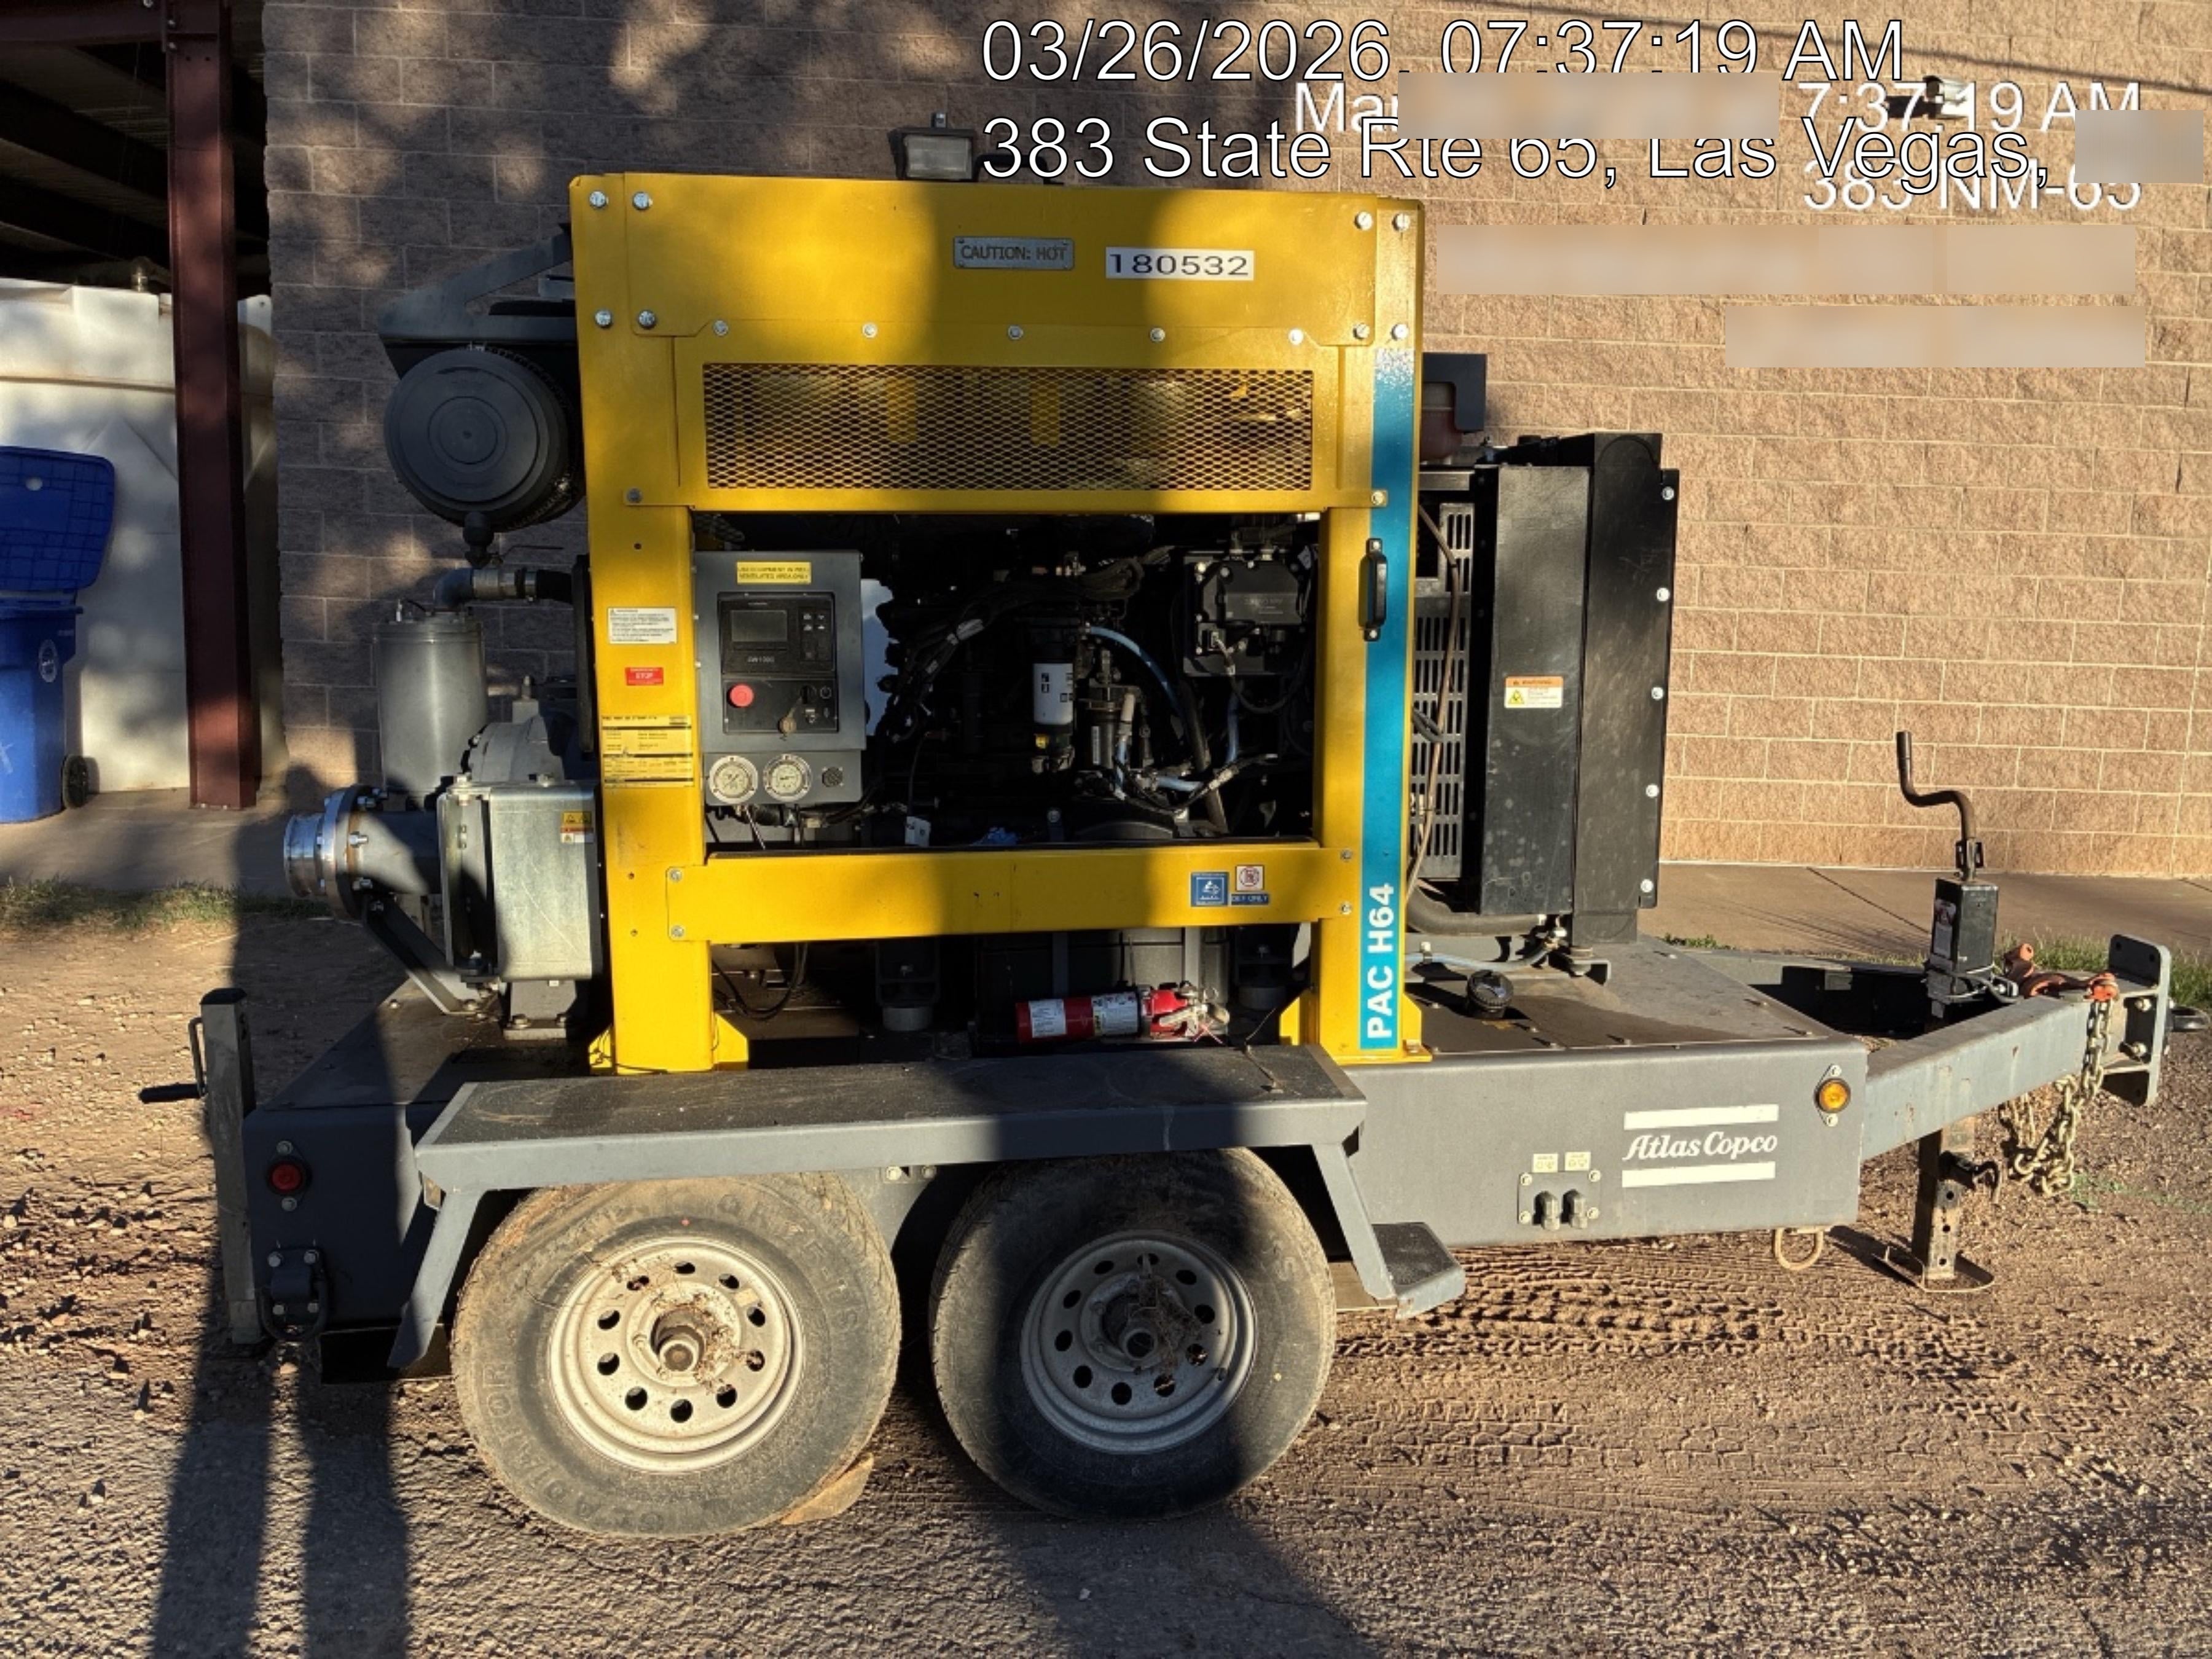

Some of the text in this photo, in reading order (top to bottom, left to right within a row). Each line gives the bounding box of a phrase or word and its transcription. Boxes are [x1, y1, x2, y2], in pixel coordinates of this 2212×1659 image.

[960, 246, 1068, 261] CAUTION: HOT
[1109, 253, 1249, 276] 180532
[1367, 882, 1395, 1038] PAC H64
[1622, 1131, 1778, 1161] Atlas Copco
